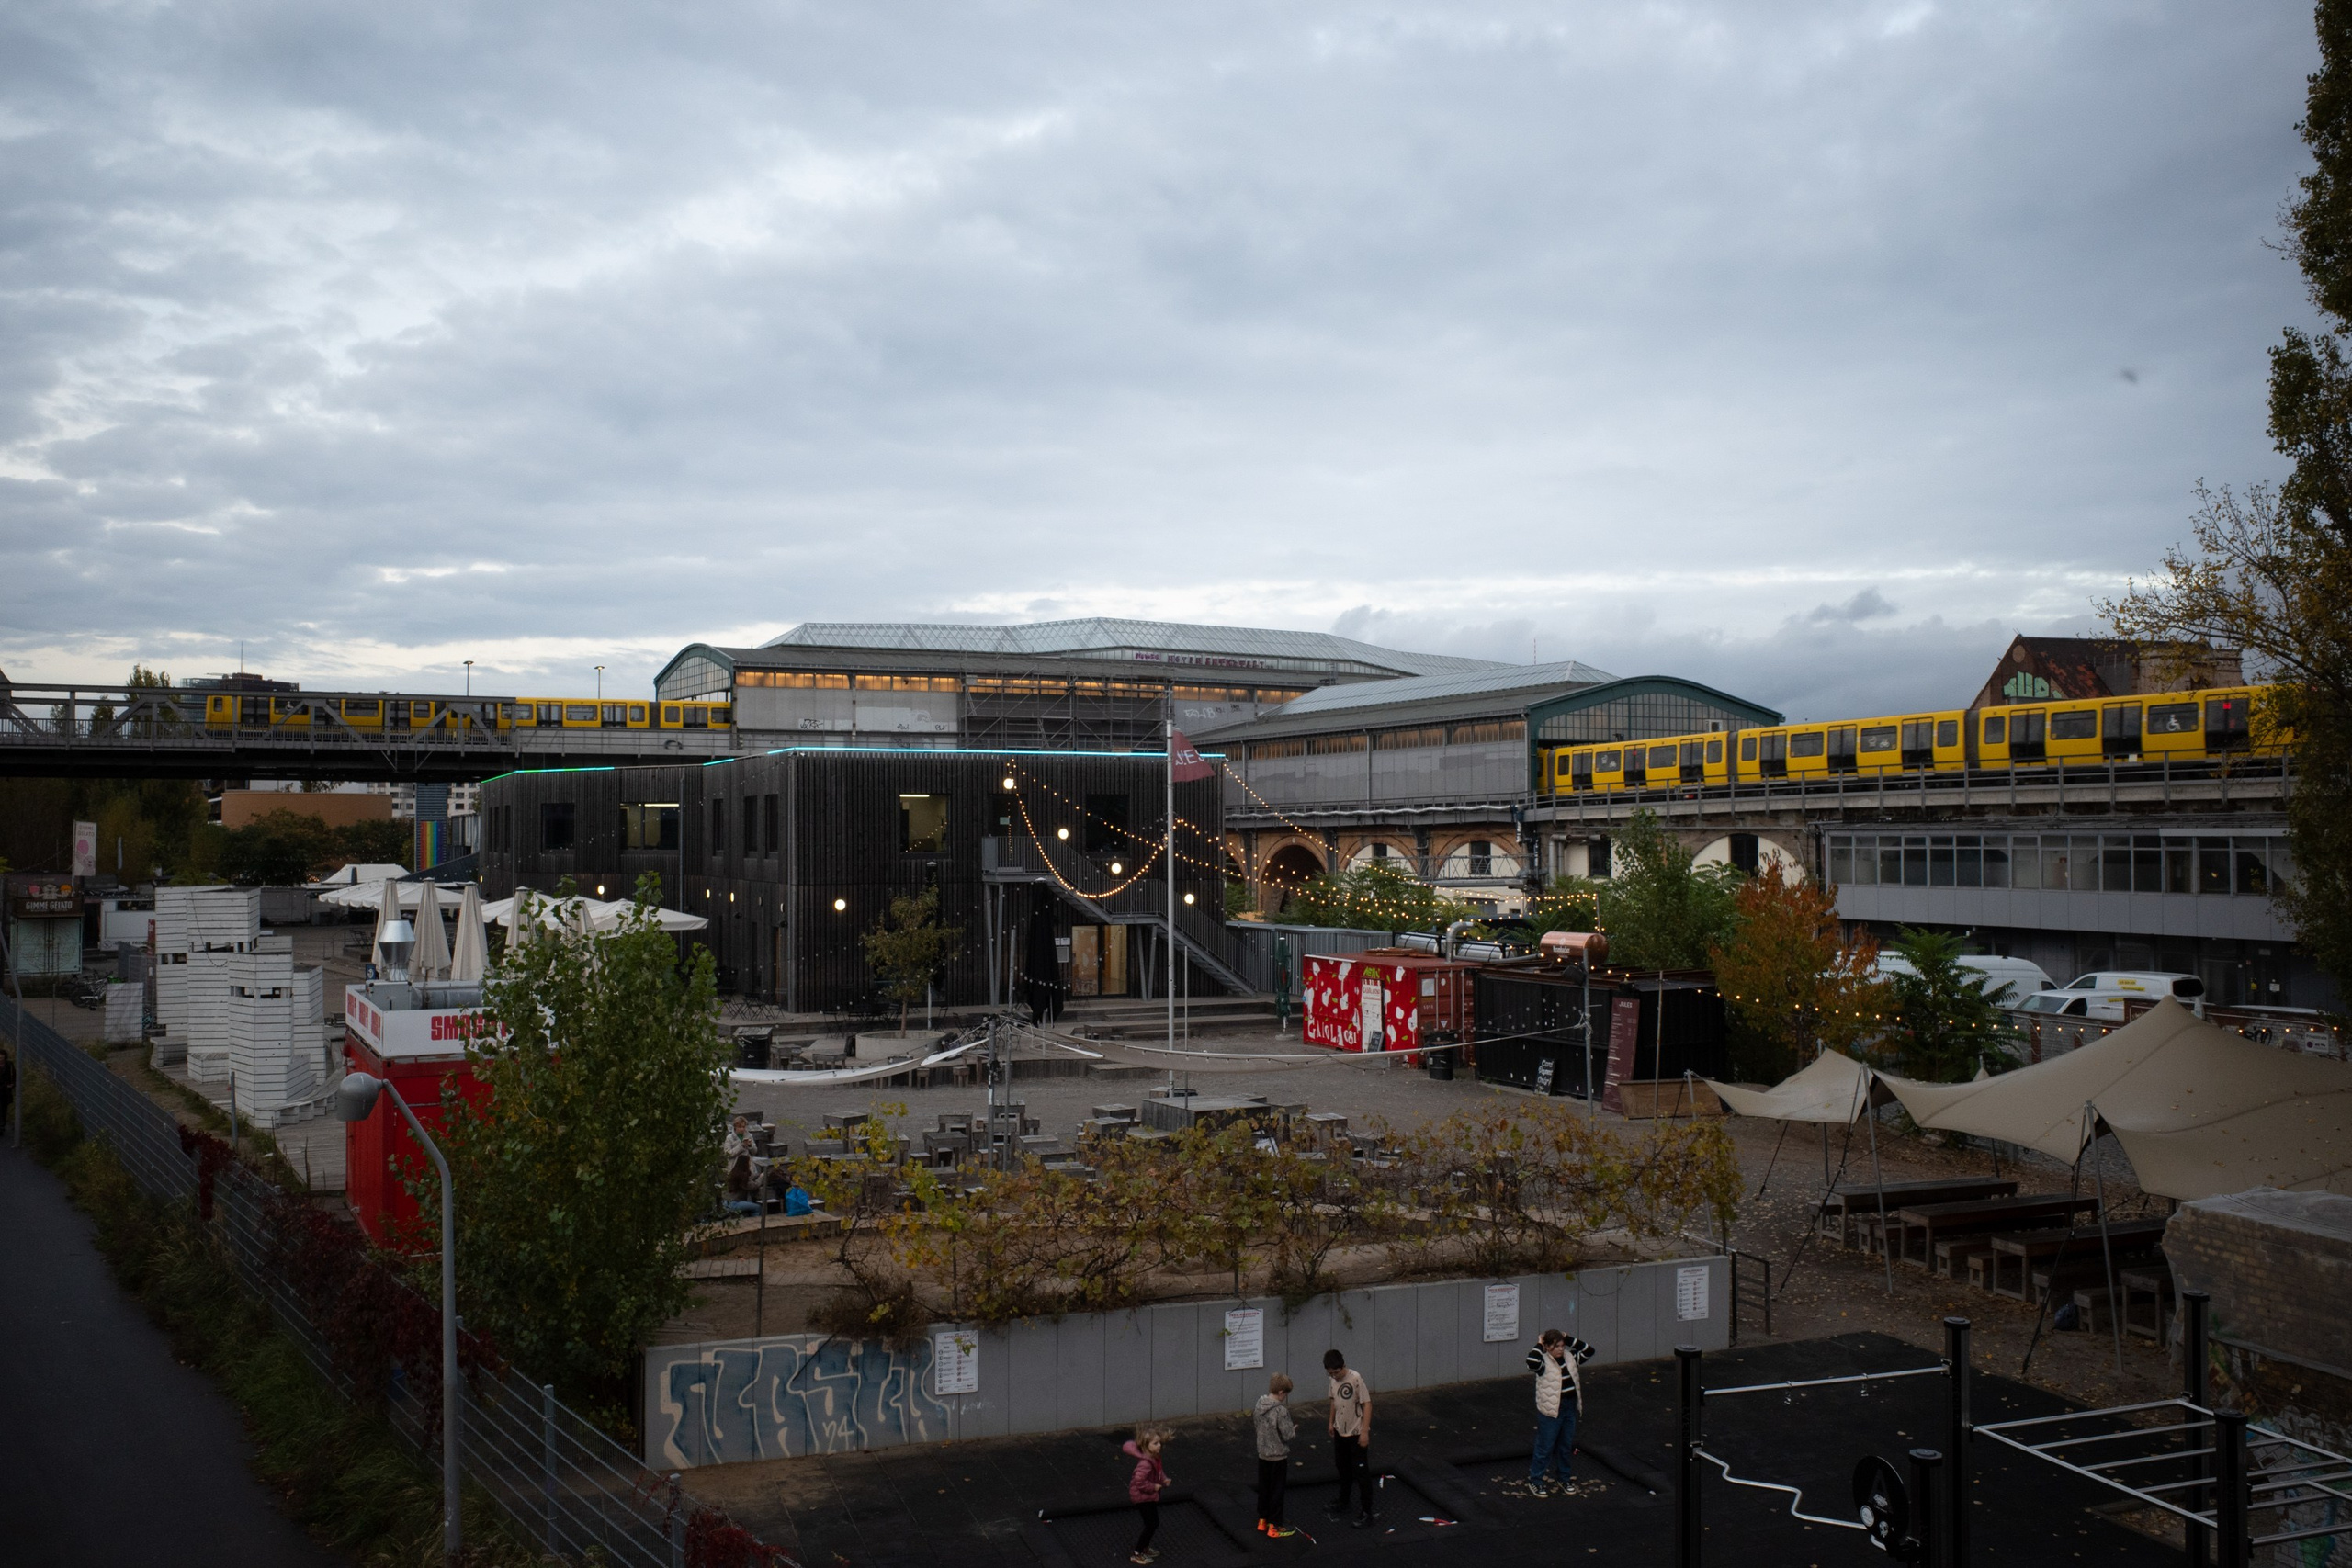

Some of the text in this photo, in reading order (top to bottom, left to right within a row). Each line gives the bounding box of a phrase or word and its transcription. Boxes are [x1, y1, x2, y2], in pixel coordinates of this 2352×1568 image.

[26, 900, 73, 910] GIMME GELATO
[1307, 1017, 1344, 1046] GAIOLA
[1542, 1059, 1554, 1067] Card
